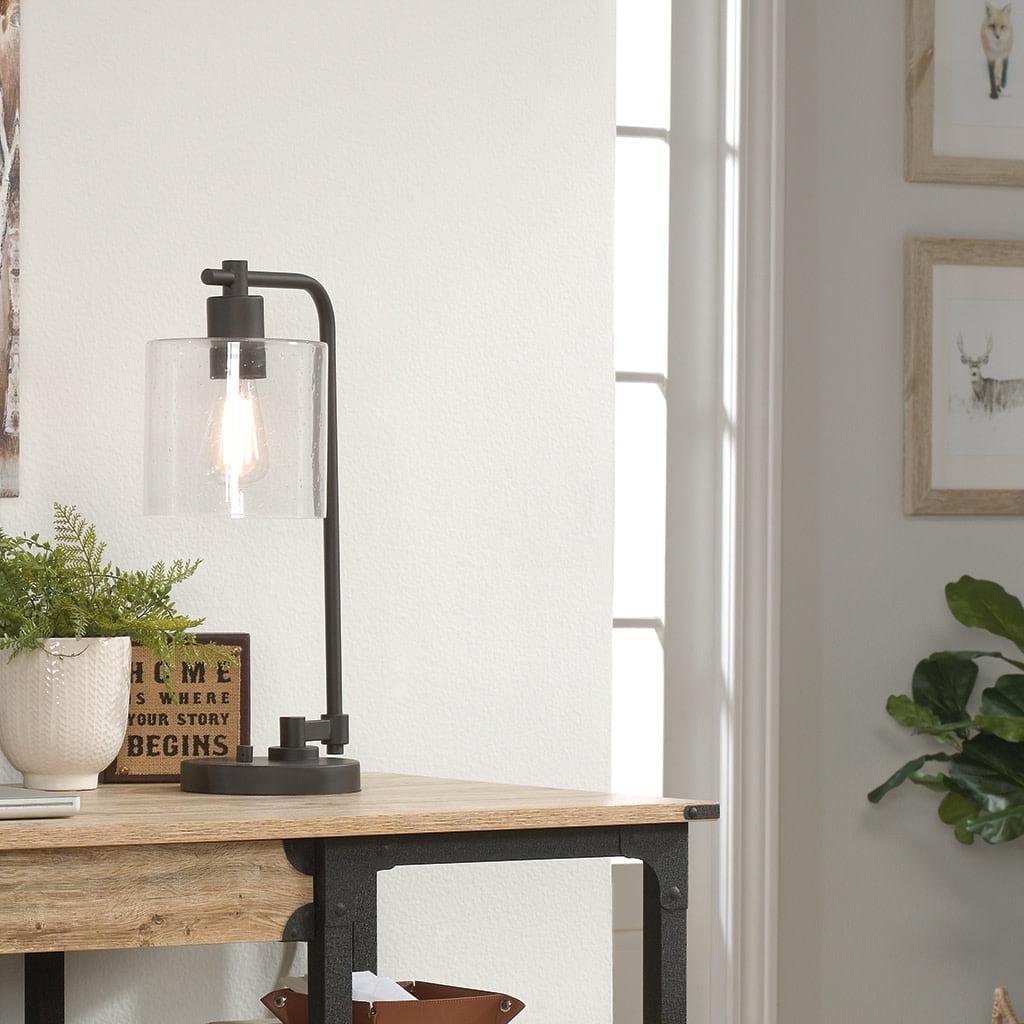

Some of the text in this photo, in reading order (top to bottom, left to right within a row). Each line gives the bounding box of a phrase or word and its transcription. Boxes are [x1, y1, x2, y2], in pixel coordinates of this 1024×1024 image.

[159, 692, 229, 704] WHERE
[128, 713, 229, 726] YOUR STORY
[127, 734, 229, 757] BEGINS
